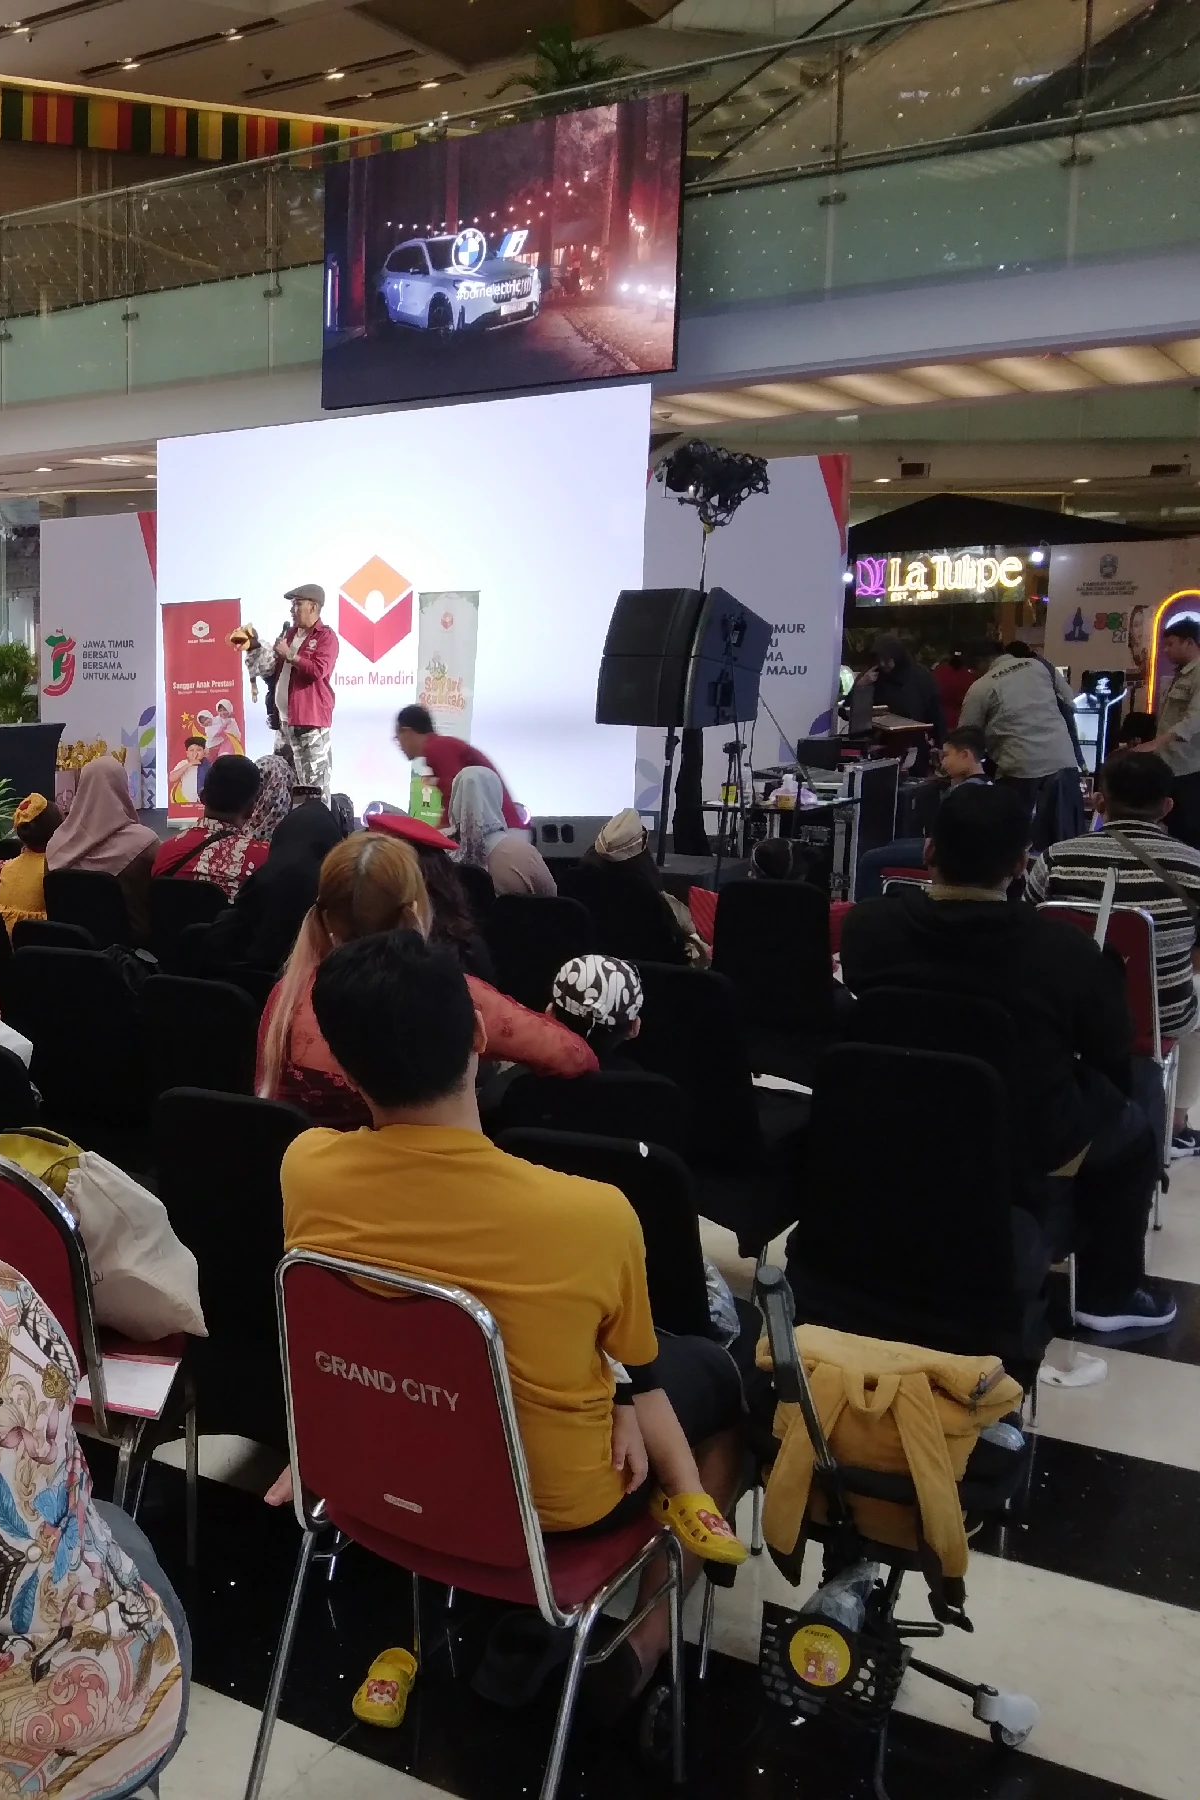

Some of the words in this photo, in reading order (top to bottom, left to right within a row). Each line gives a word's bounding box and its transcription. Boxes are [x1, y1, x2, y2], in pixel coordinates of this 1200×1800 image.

[887, 557, 928, 592] La
[930, 554, 1023, 594] Tulipe
[772, 623, 806, 634] MUR
[82, 640, 106, 649] JAWA
[108, 640, 135, 648] TIMUR
[82, 650, 119, 659] BERSATU
[82, 662, 122, 670] BERSAMA
[766, 666, 808, 676] MAJU
[82, 672, 111, 680] UNTUK
[112, 672, 137, 680] MAJU
[334, 672, 364, 686] Insan
[368, 670, 414, 686] Mandiri
[314, 1350, 397, 1394] GRAND
[401, 1378, 460, 1412] CITY
